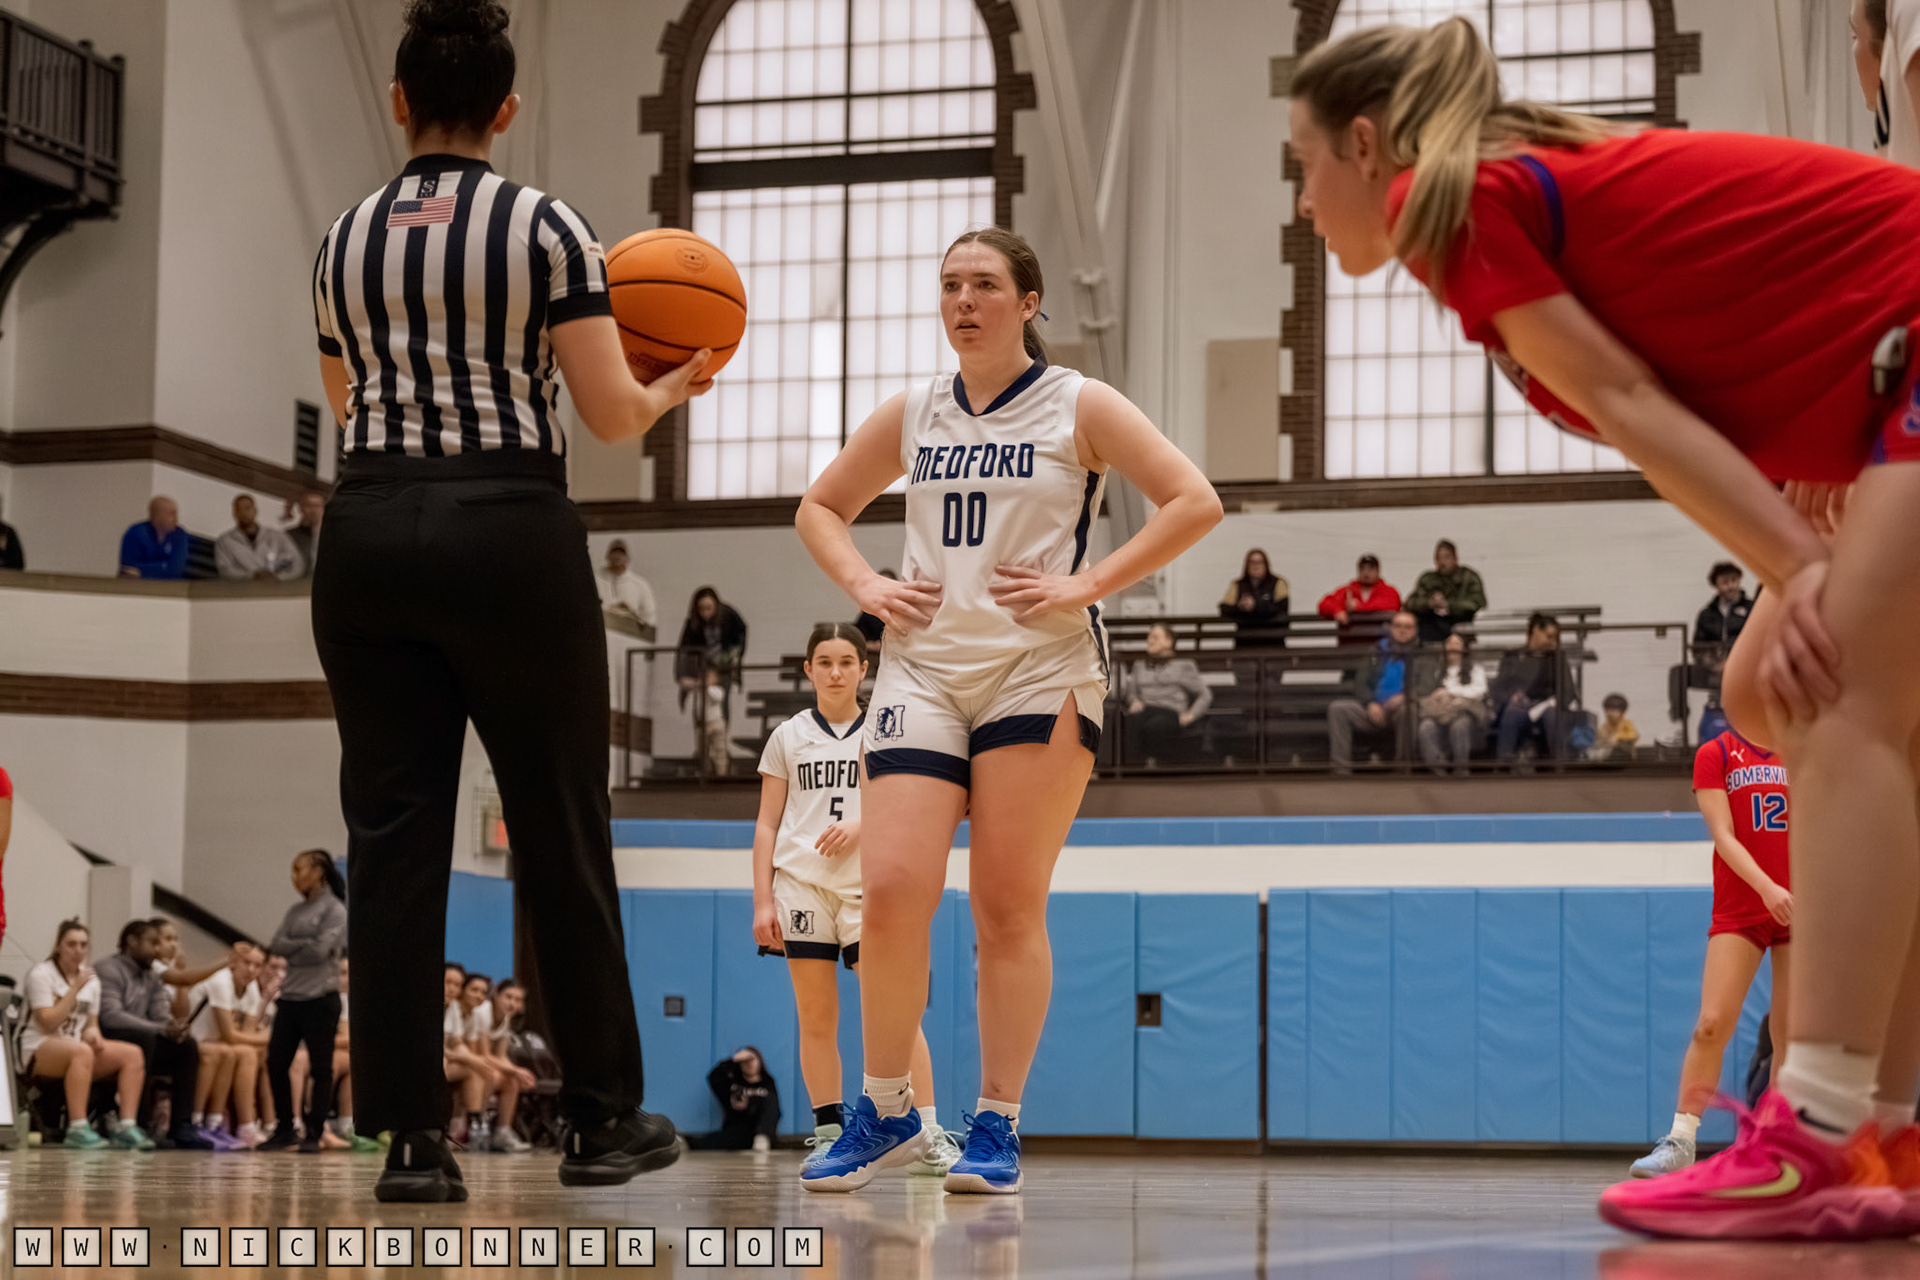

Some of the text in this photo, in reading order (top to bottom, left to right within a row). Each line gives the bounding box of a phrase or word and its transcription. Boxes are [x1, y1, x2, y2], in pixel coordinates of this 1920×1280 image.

[911, 443, 1034, 485] MEDFORD
[942, 491, 986, 547] 00
[797, 760, 861, 791] MEDFO
[1725, 765, 1789, 794] SOMERVI
[1751, 793, 1788, 832] 12
